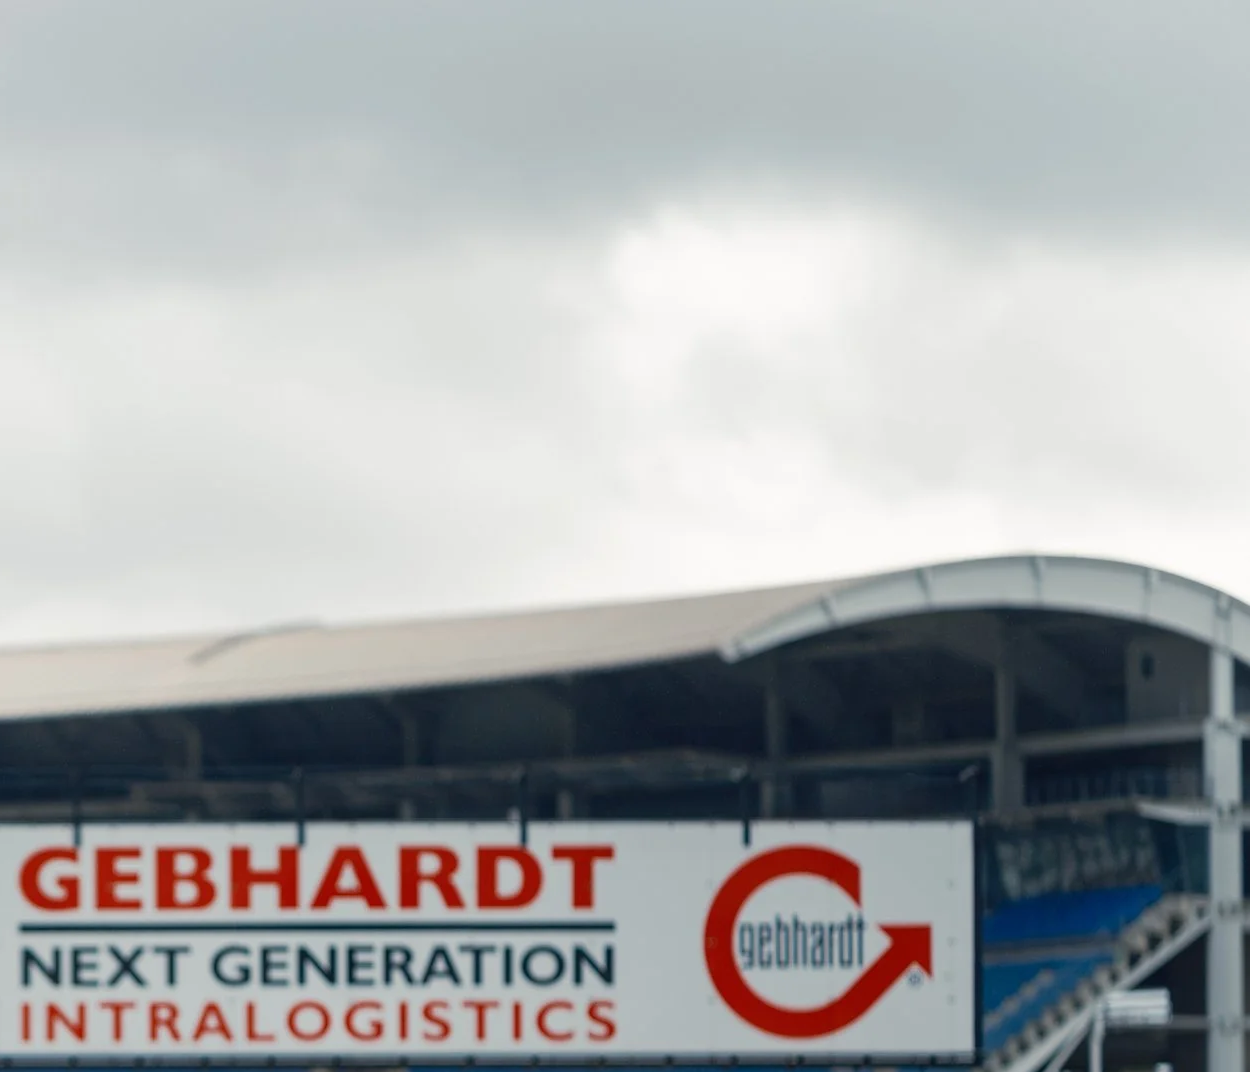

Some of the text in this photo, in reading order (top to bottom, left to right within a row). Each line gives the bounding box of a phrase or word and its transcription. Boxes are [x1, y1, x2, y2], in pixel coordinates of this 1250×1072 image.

[18, 844, 616, 912] GEBHARDT
[20, 943, 616, 988] NEXT GENERATION
[738, 912, 867, 970] gebhardt
[20, 1000, 616, 1044] INTRALOGISTICS
